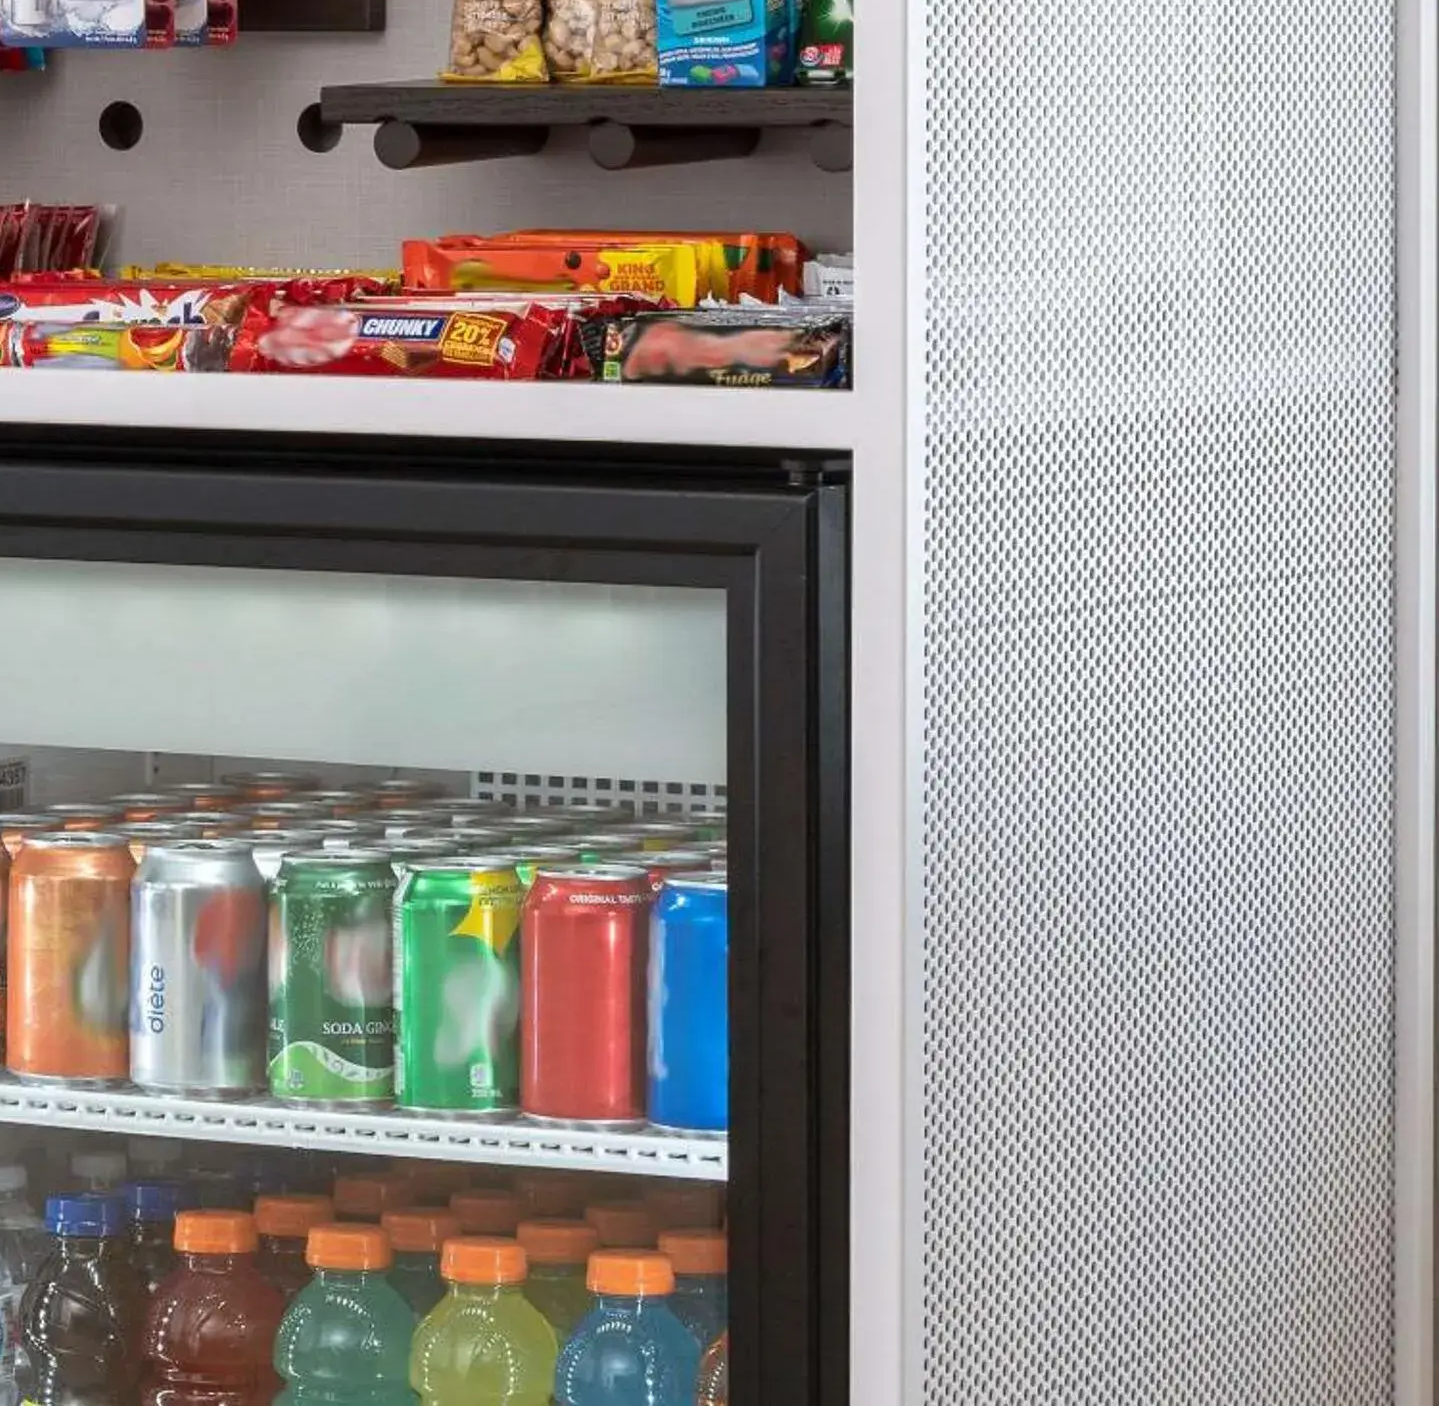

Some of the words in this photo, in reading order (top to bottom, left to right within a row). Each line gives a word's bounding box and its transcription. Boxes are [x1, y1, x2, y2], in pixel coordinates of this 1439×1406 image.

[616, 262, 656, 275] KING
[610, 279, 665, 292] GRAND
[362, 317, 440, 336] CHUNKY
[449, 320, 492, 346] 20%
[569, 893, 617, 904] ORIGINAL
[322, 1021, 363, 1035] SODA
